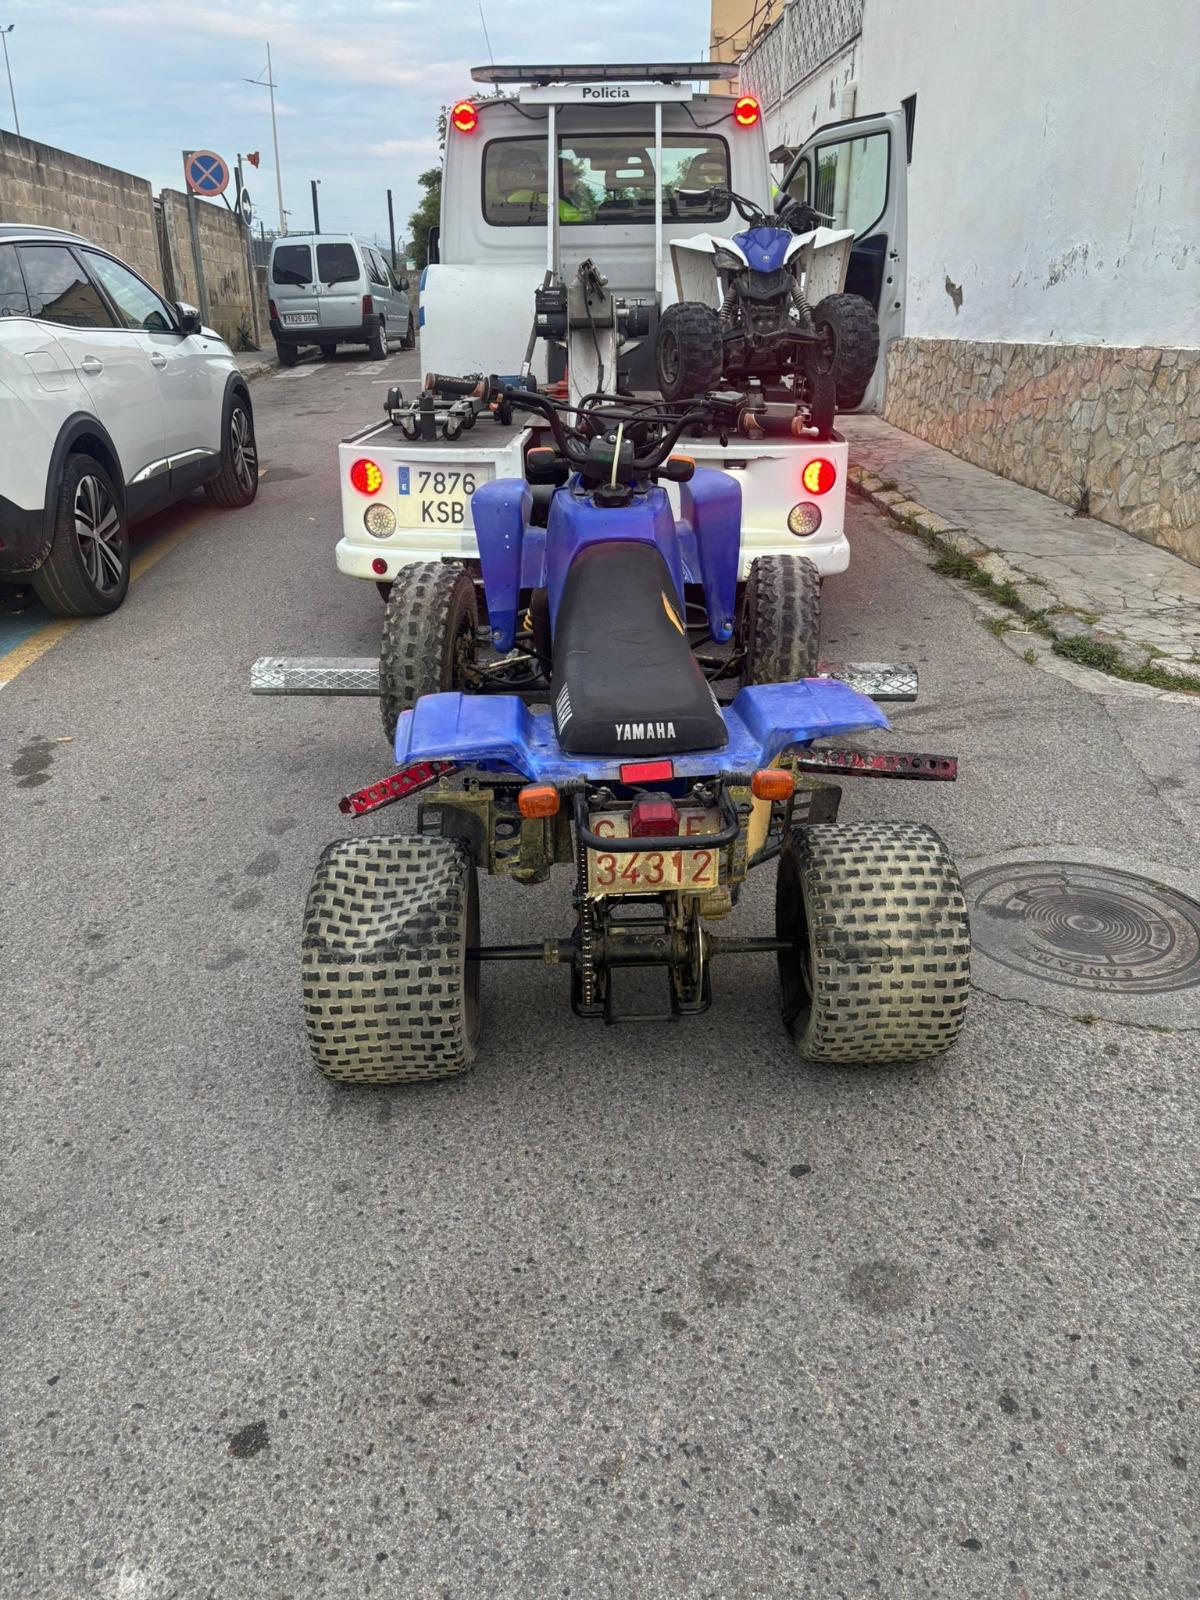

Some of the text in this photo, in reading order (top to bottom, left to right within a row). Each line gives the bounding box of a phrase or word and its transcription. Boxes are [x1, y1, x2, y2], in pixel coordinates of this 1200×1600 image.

[582, 86, 631, 98] Policia
[418, 471, 476, 495] 7876
[422, 500, 465, 523] KSB
[615, 722, 676, 741] YAMAHA
[596, 850, 712, 886] 34312
